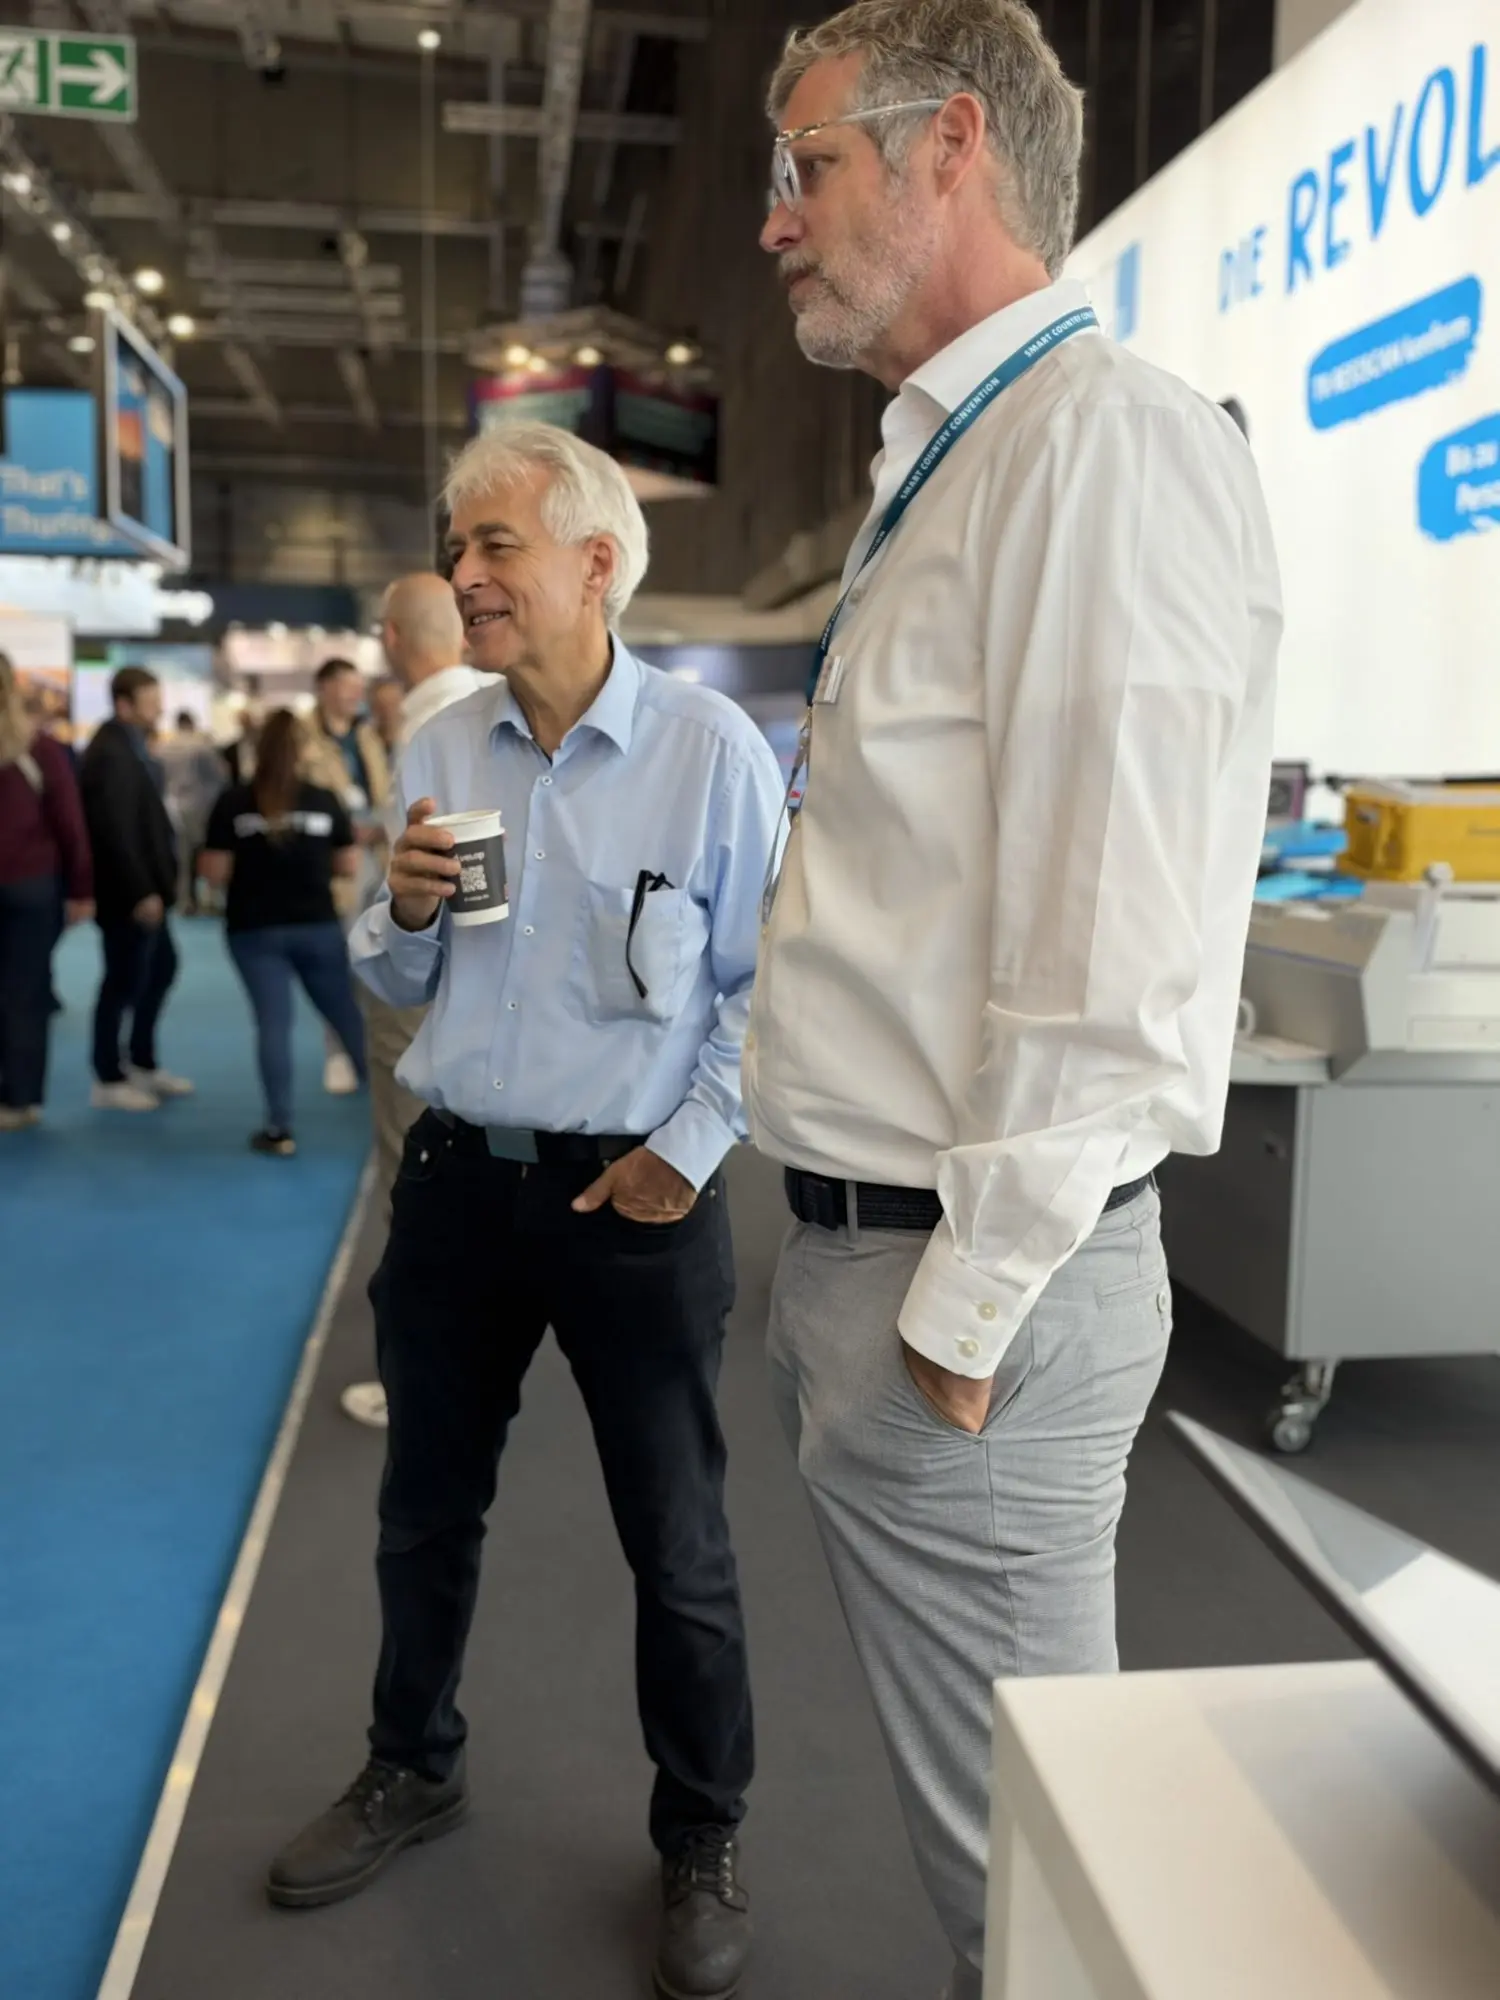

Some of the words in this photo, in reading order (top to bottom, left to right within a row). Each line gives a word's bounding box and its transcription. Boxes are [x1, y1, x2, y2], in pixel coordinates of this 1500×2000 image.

[1286, 42, 1500, 294] REVOL
[1024, 333, 1052, 357] SMART
[1051, 313, 1082, 337] COUNTRY
[900, 470, 923, 499] SMART
[921, 429, 951, 470] COUNTRY
[949, 377, 1000, 430] CONVENTION
